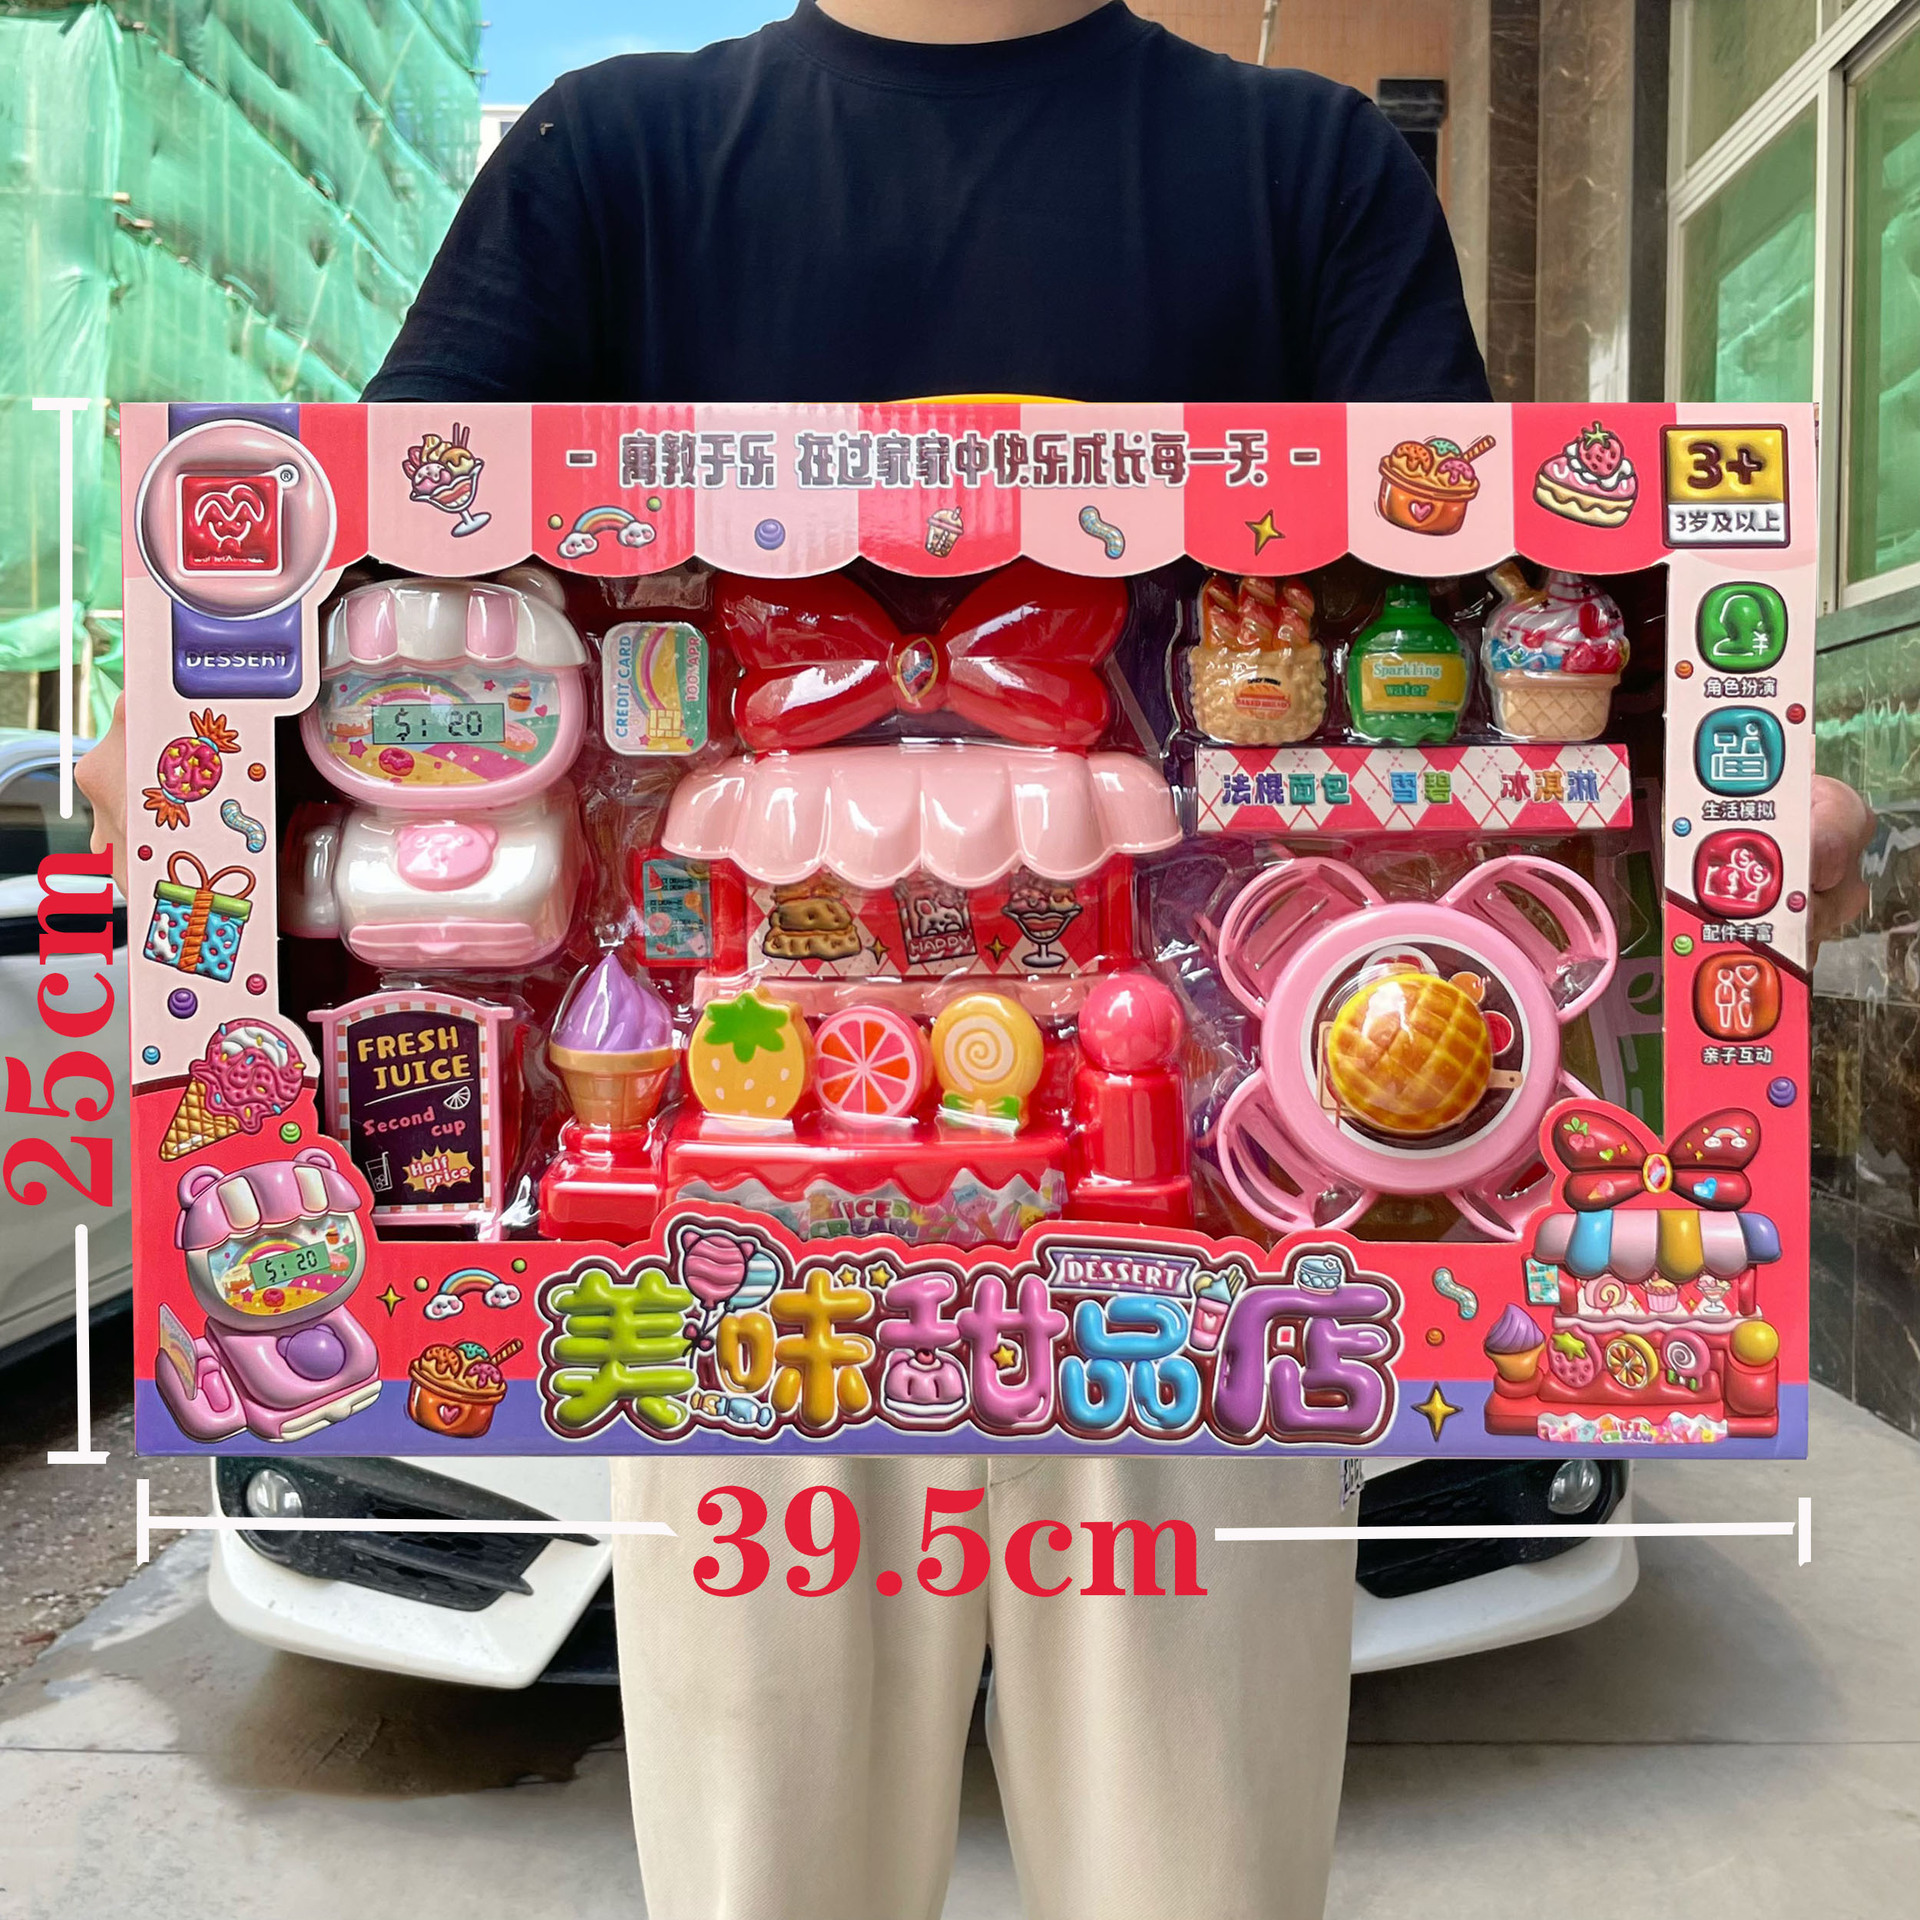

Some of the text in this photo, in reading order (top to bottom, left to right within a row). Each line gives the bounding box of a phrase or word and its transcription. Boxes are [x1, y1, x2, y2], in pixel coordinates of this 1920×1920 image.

[620, 430, 1267, 488] 寓教于乐 在过家家中快乐成长每一天
[1687, 441, 1764, 490] 3+
[1674, 510, 1780, 533] 3岁及以上
[185, 648, 290, 668] DESSERT
[1373, 662, 1441, 679] Sparkling
[615, 635, 633, 738] CREDIT CARD
[1384, 682, 1429, 697] water
[1704, 678, 1777, 698] 角色扮演
[448, 710, 482, 736] 20
[1221, 770, 1601, 806] 法棍面包 雪碧 冰淇淋
[1702, 802, 1776, 820] 生活模拟
[1702, 924, 1773, 944] 配件丰富
[357, 1026, 460, 1063] FRESH
[1702, 1047, 1773, 1065] 亲子互动
[373, 1054, 472, 1090] JUICE
[362, 1105, 436, 1136] Second
[430, 1119, 467, 1137] cup
[409, 1156, 449, 1178] Half
[424, 1166, 470, 1191] price
[1066, 1260, 1179, 1289] DESSERT
[552, 1268, 1395, 1434] 美味甜品店
